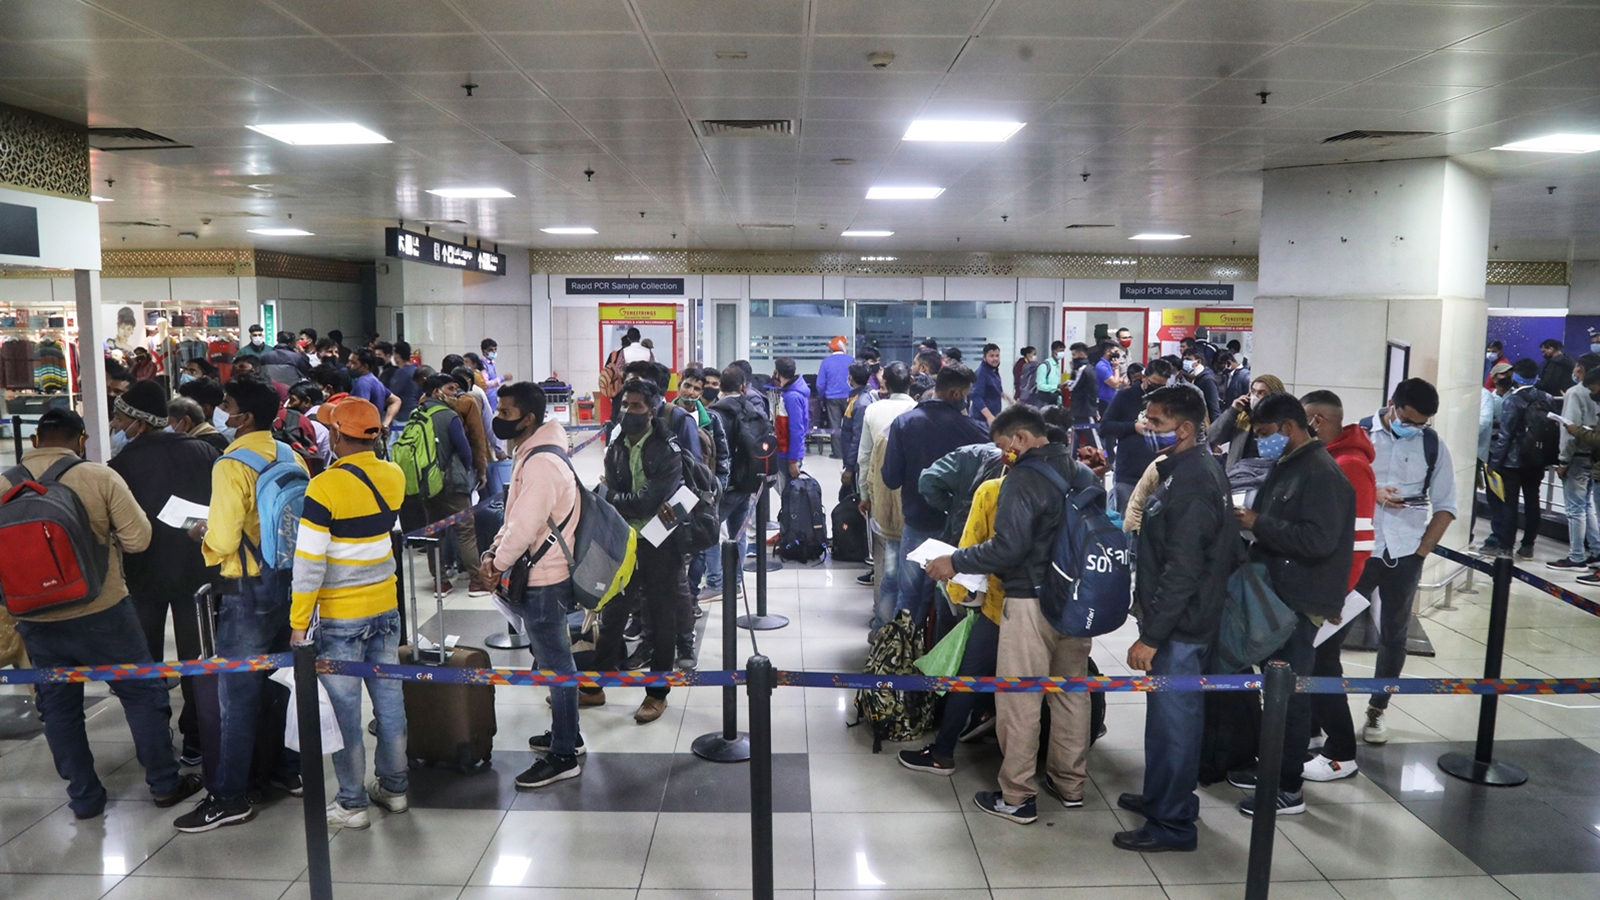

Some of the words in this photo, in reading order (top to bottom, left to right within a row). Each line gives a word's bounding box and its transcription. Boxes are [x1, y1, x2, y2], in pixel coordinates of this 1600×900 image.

[571, 282, 592, 290] Rapid
[611, 282, 639, 290] Sample
[641, 282, 677, 290] Collection
[1125, 286, 1146, 295] Rapid
[1164, 287, 1191, 295] Sample
[1192, 287, 1228, 295] Collection
[1220, 313, 1253, 322] GENESTRING
